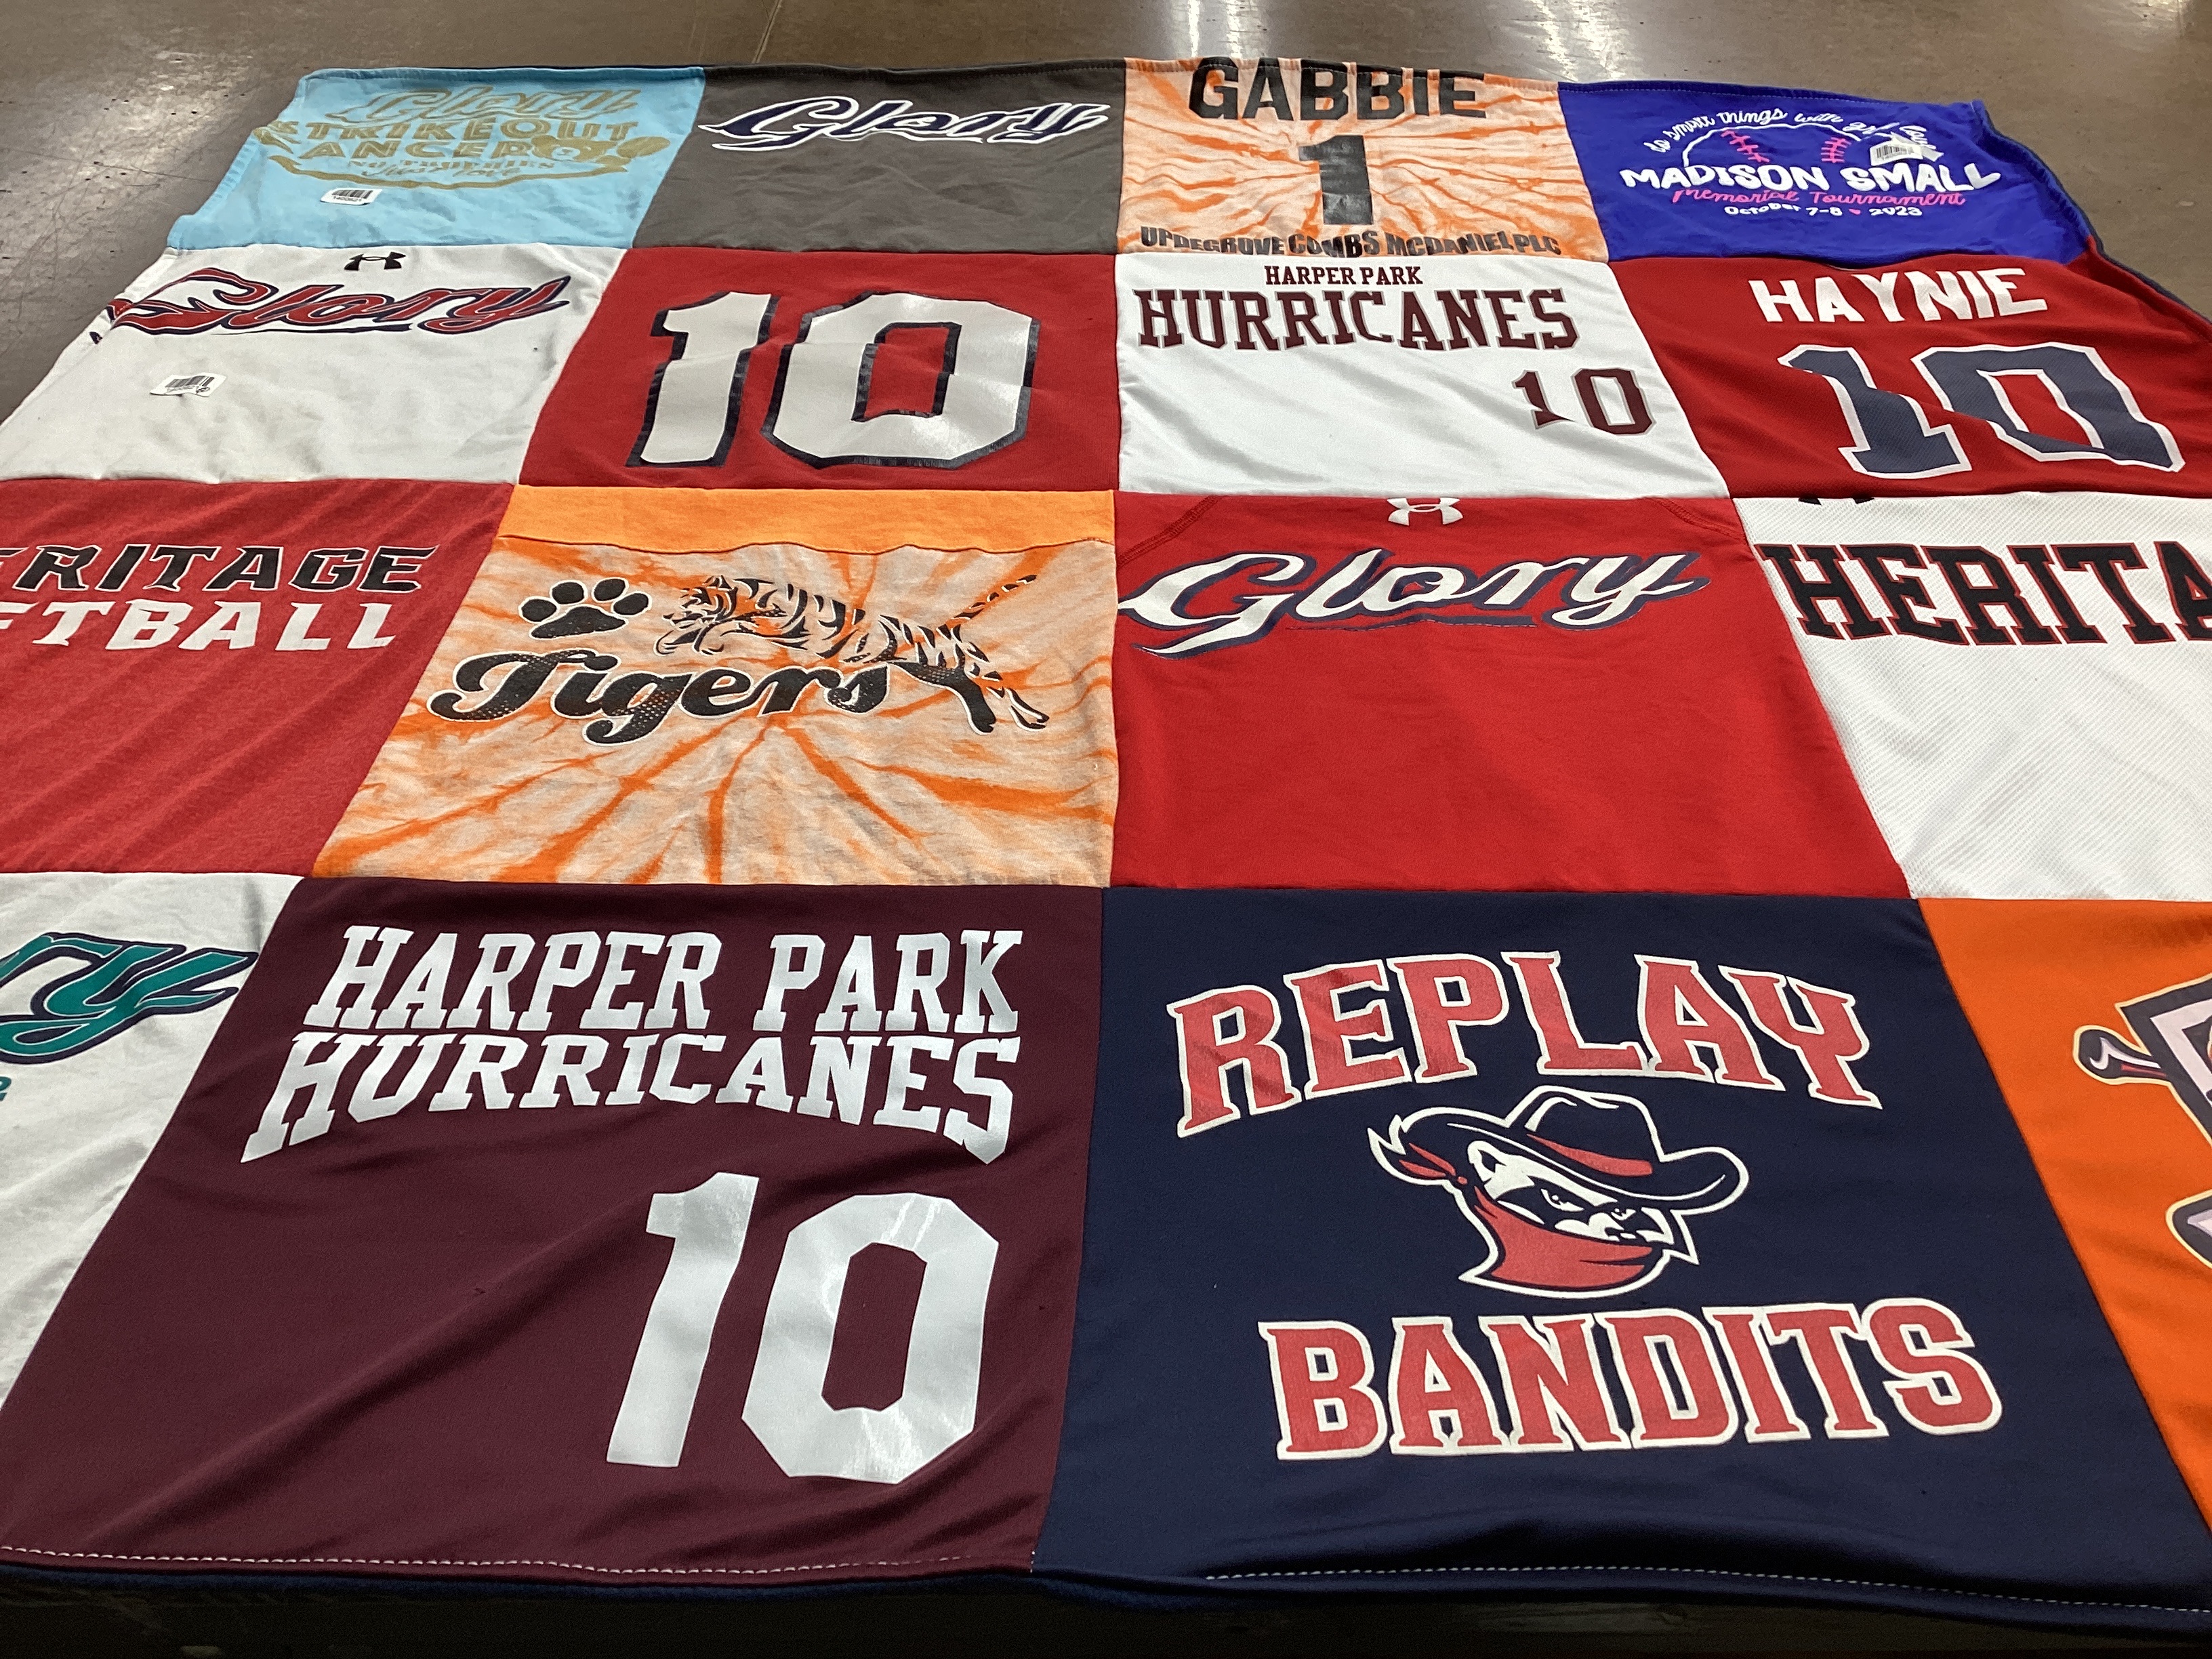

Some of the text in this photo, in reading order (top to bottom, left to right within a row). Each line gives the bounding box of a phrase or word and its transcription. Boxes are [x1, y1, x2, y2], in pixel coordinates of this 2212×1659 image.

[698, 96, 1111, 150] Glory
[1189, 57, 1487, 120] GABBIE
[1298, 134, 1374, 225] 1
[1619, 162, 2001, 192] MADISON SMALL
[1672, 187, 1966, 206] Memorial Tournament
[1723, 203, 1801, 216] October
[1868, 207, 1923, 217] 2023
[1141, 226, 1285, 255] UPDEGROVE
[1288, 230, 1380, 258] COMBS
[1512, 233, 1562, 255] PLC
[1264, 265, 1423, 285] HARPER PARK
[89, 267, 572, 336] Glory
[1132, 288, 1581, 352] HURRICANES
[1748, 268, 2047, 323] HAYNIE
[625, 290, 1040, 469] 10
[1511, 367, 1658, 436] 10
[1778, 342, 2186, 478] 10
[1118, 548, 1711, 660] Glory
[426, 649, 890, 746] Tigers
[303, 926, 722, 1031] HARPER
[752, 930, 1023, 1033] PARK
[1166, 950, 1883, 1139] REPLAY
[241, 1031, 1021, 1164] HURRICANES
[607, 1172, 1000, 1484] 10
[1258, 1296, 2003, 1460] BANDITS
